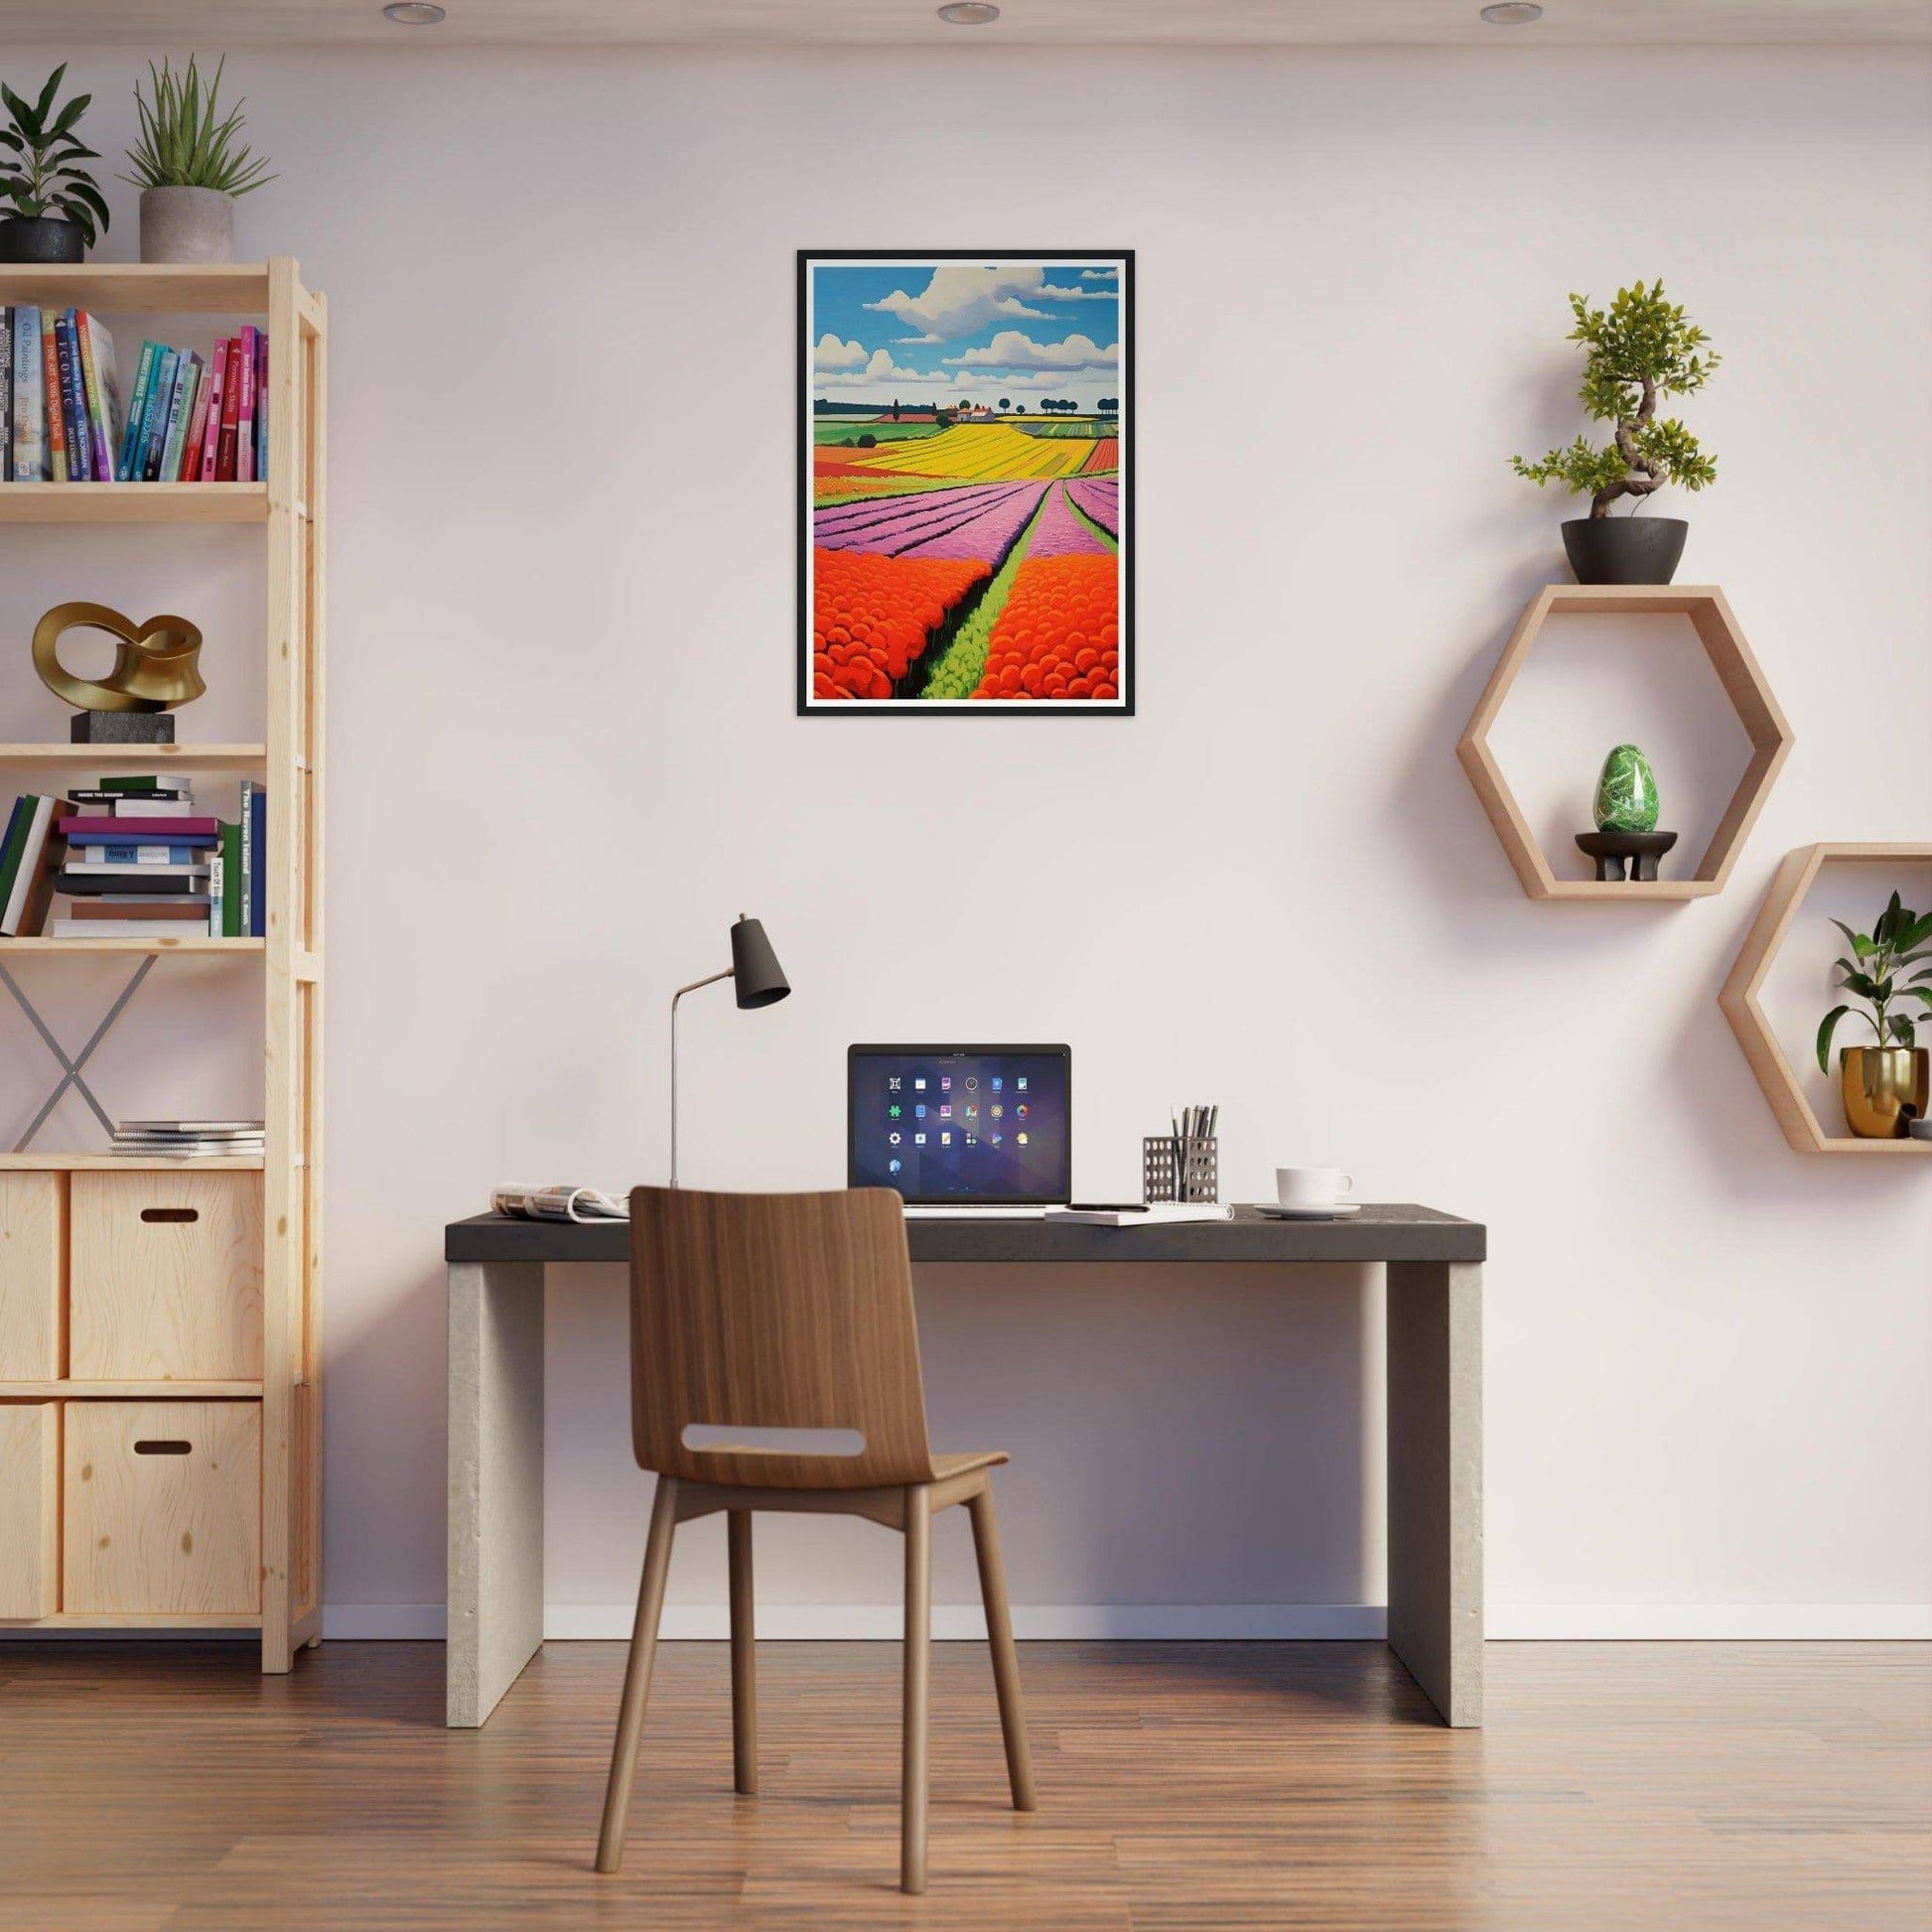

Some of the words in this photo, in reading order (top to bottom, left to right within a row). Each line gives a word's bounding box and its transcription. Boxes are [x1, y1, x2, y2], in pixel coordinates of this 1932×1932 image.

[22, 324, 34, 338] Oil
[46, 345, 55, 361] FINE
[78, 325, 92, 371] Watercolor
[18, 340, 33, 383] Paintings
[48, 361, 57, 377] ART
[59, 342, 73, 405] ICONIC
[228, 360, 240, 394] Parenting
[49, 382, 59, 399] With
[73, 391, 82, 405] ART
[48, 399, 61, 423] Digital
[227, 395, 237, 413] Skills
[140, 393, 157, 444] SUCCESSFUL
[52, 423, 62, 440] Tools
[242, 788, 251, 808] The
